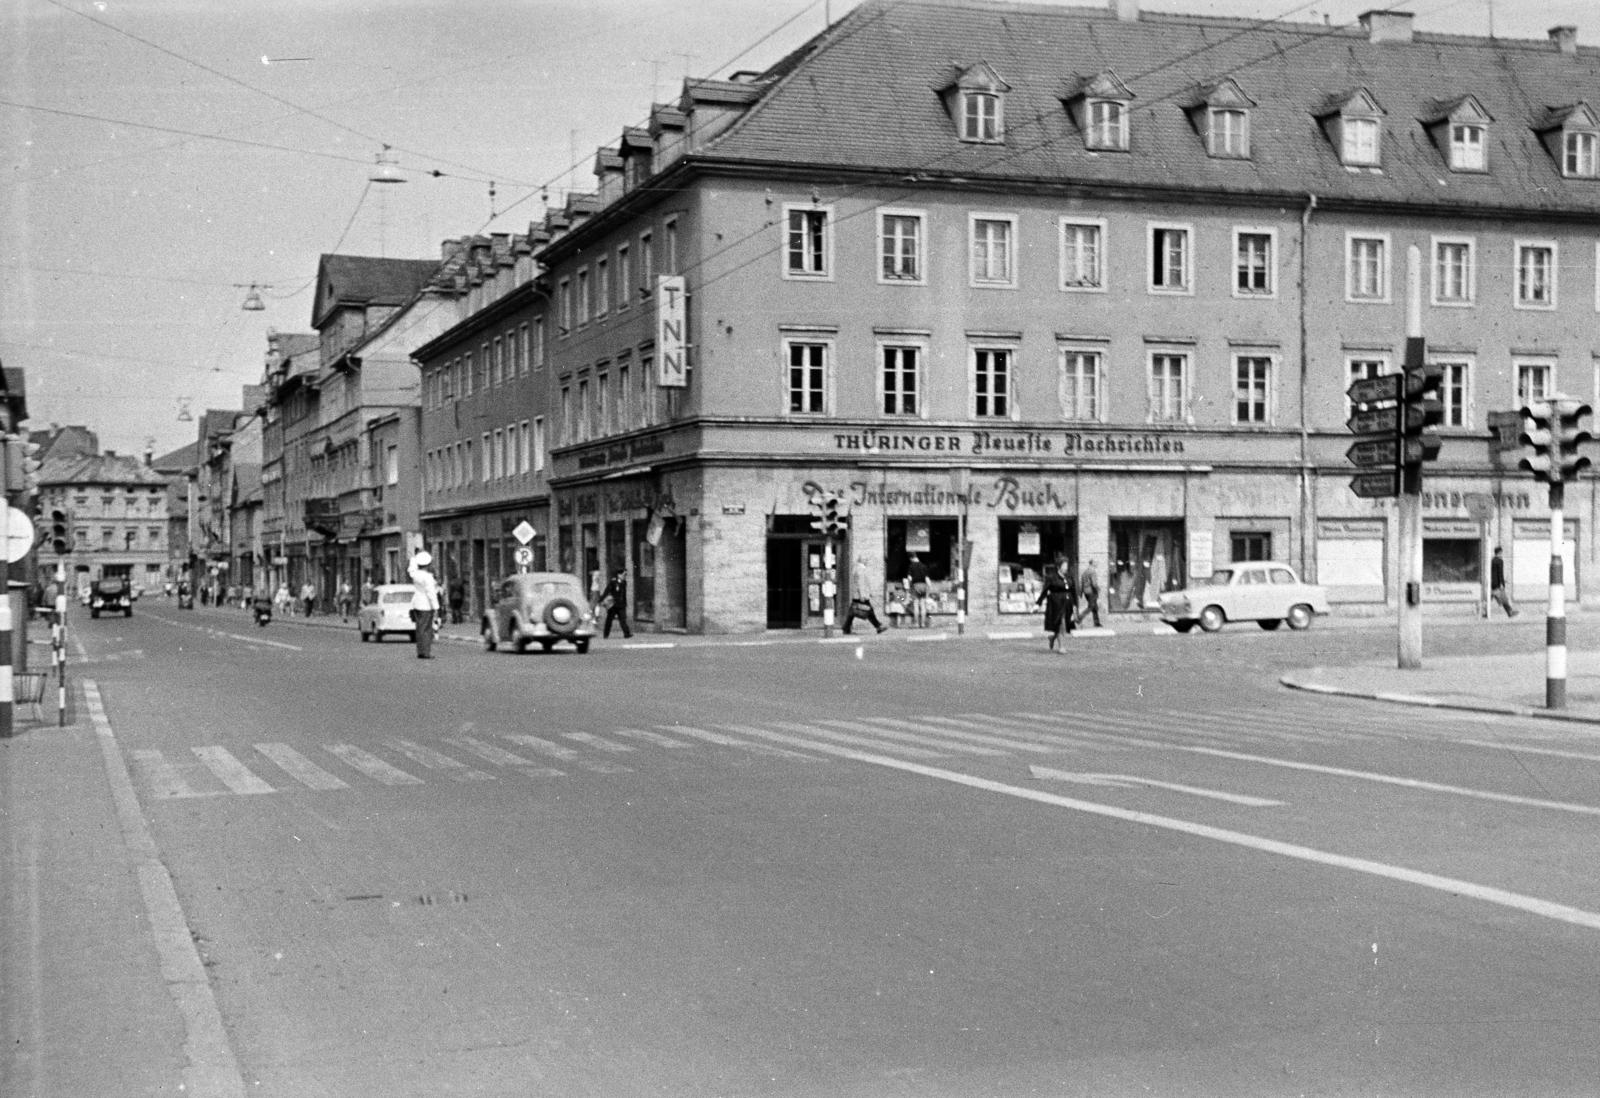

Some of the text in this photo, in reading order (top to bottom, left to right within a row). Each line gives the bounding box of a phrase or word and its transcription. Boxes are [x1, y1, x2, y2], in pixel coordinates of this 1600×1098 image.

[663, 286, 682, 375] TNN
[833, 429, 1185, 456] THÜRINGER Neueste Nachrichten
[801, 481, 845, 506] Ds
[986, 476, 1067, 510] Buch
